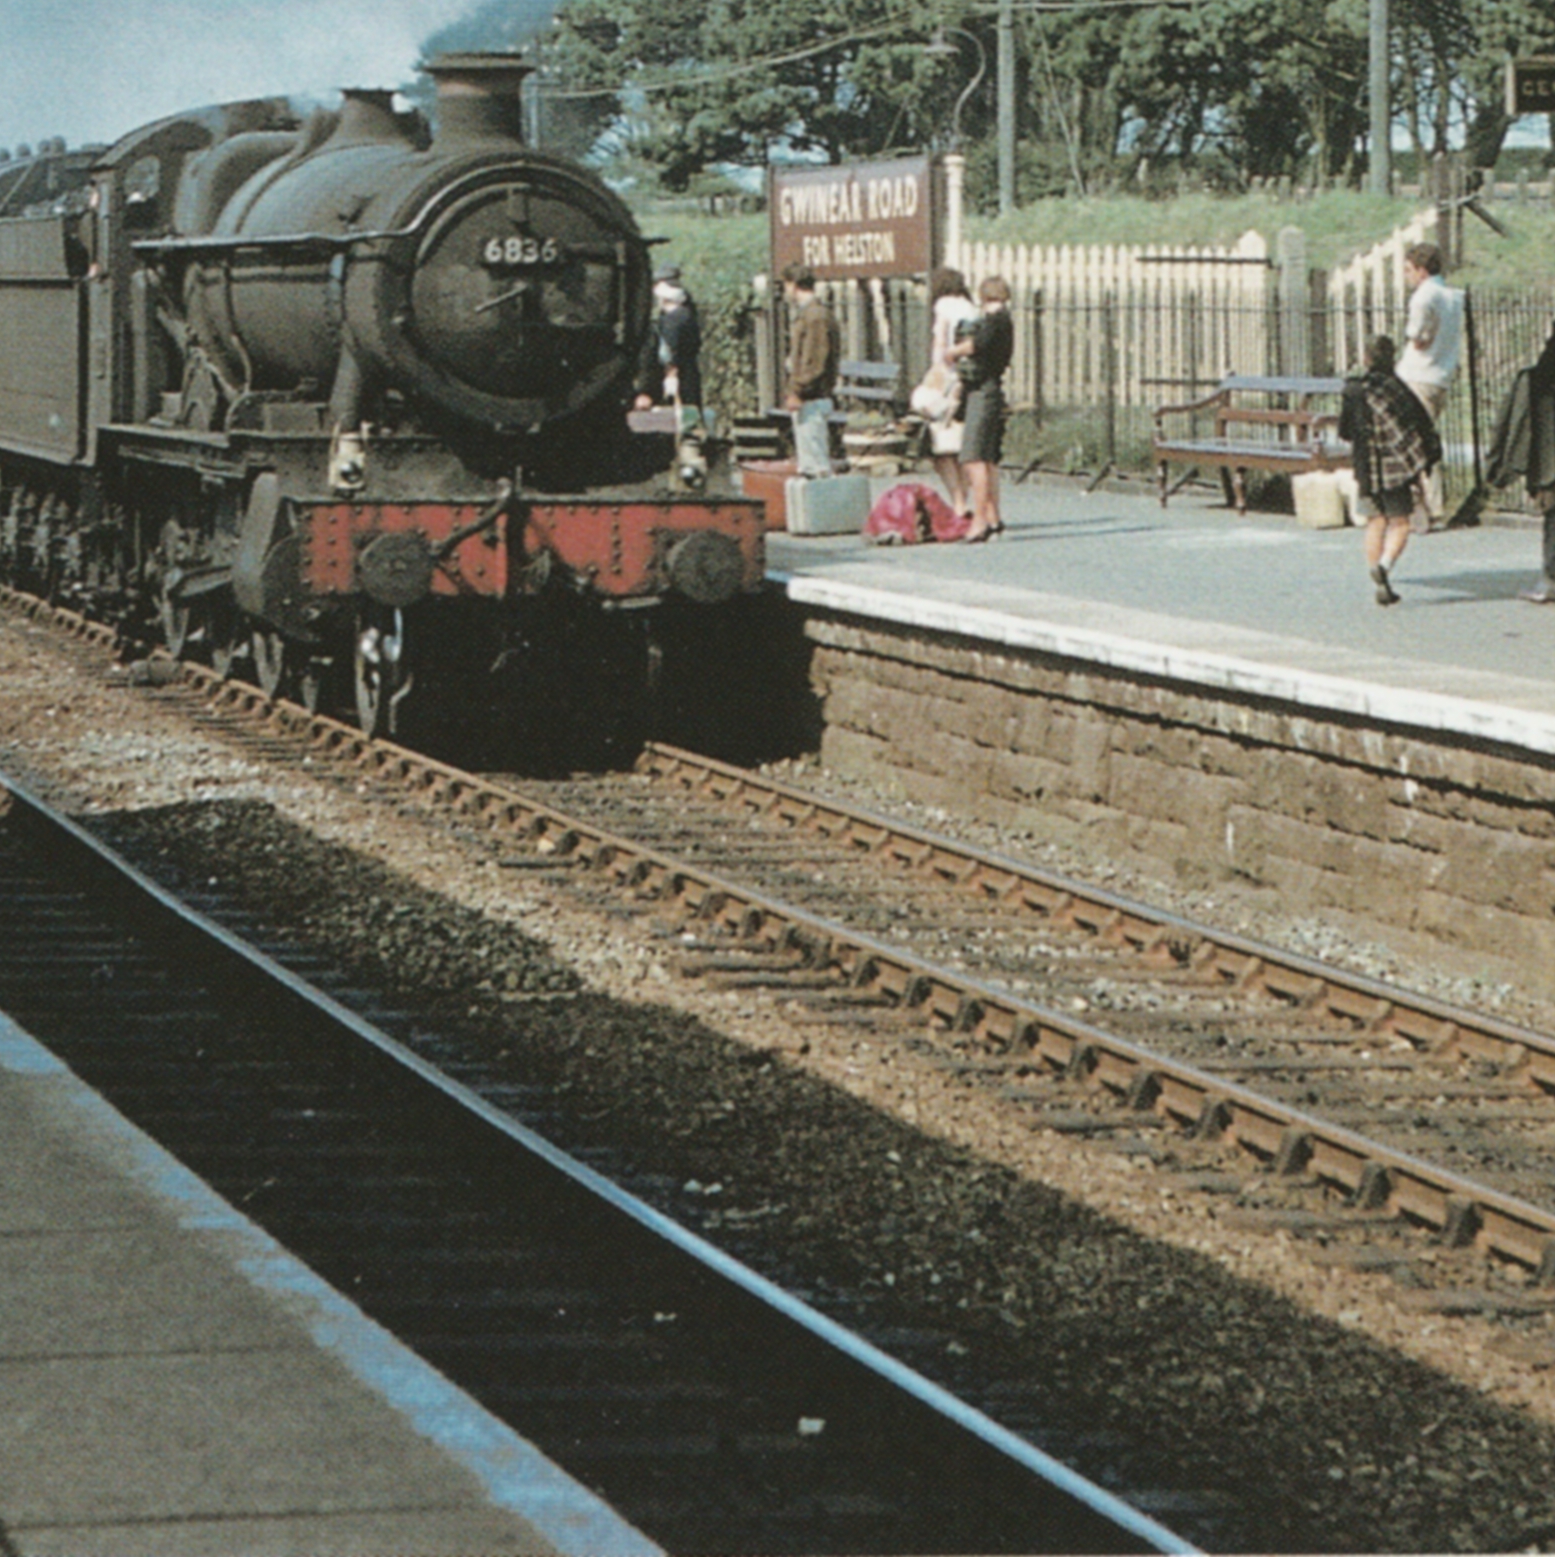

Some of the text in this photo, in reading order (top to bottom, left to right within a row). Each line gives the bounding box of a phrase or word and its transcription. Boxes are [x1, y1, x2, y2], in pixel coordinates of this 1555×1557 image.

[780, 174, 918, 226] GWINEAR ROAD
[485, 236, 557, 263] 6836
[803, 231, 895, 266] FOR HELSTON
